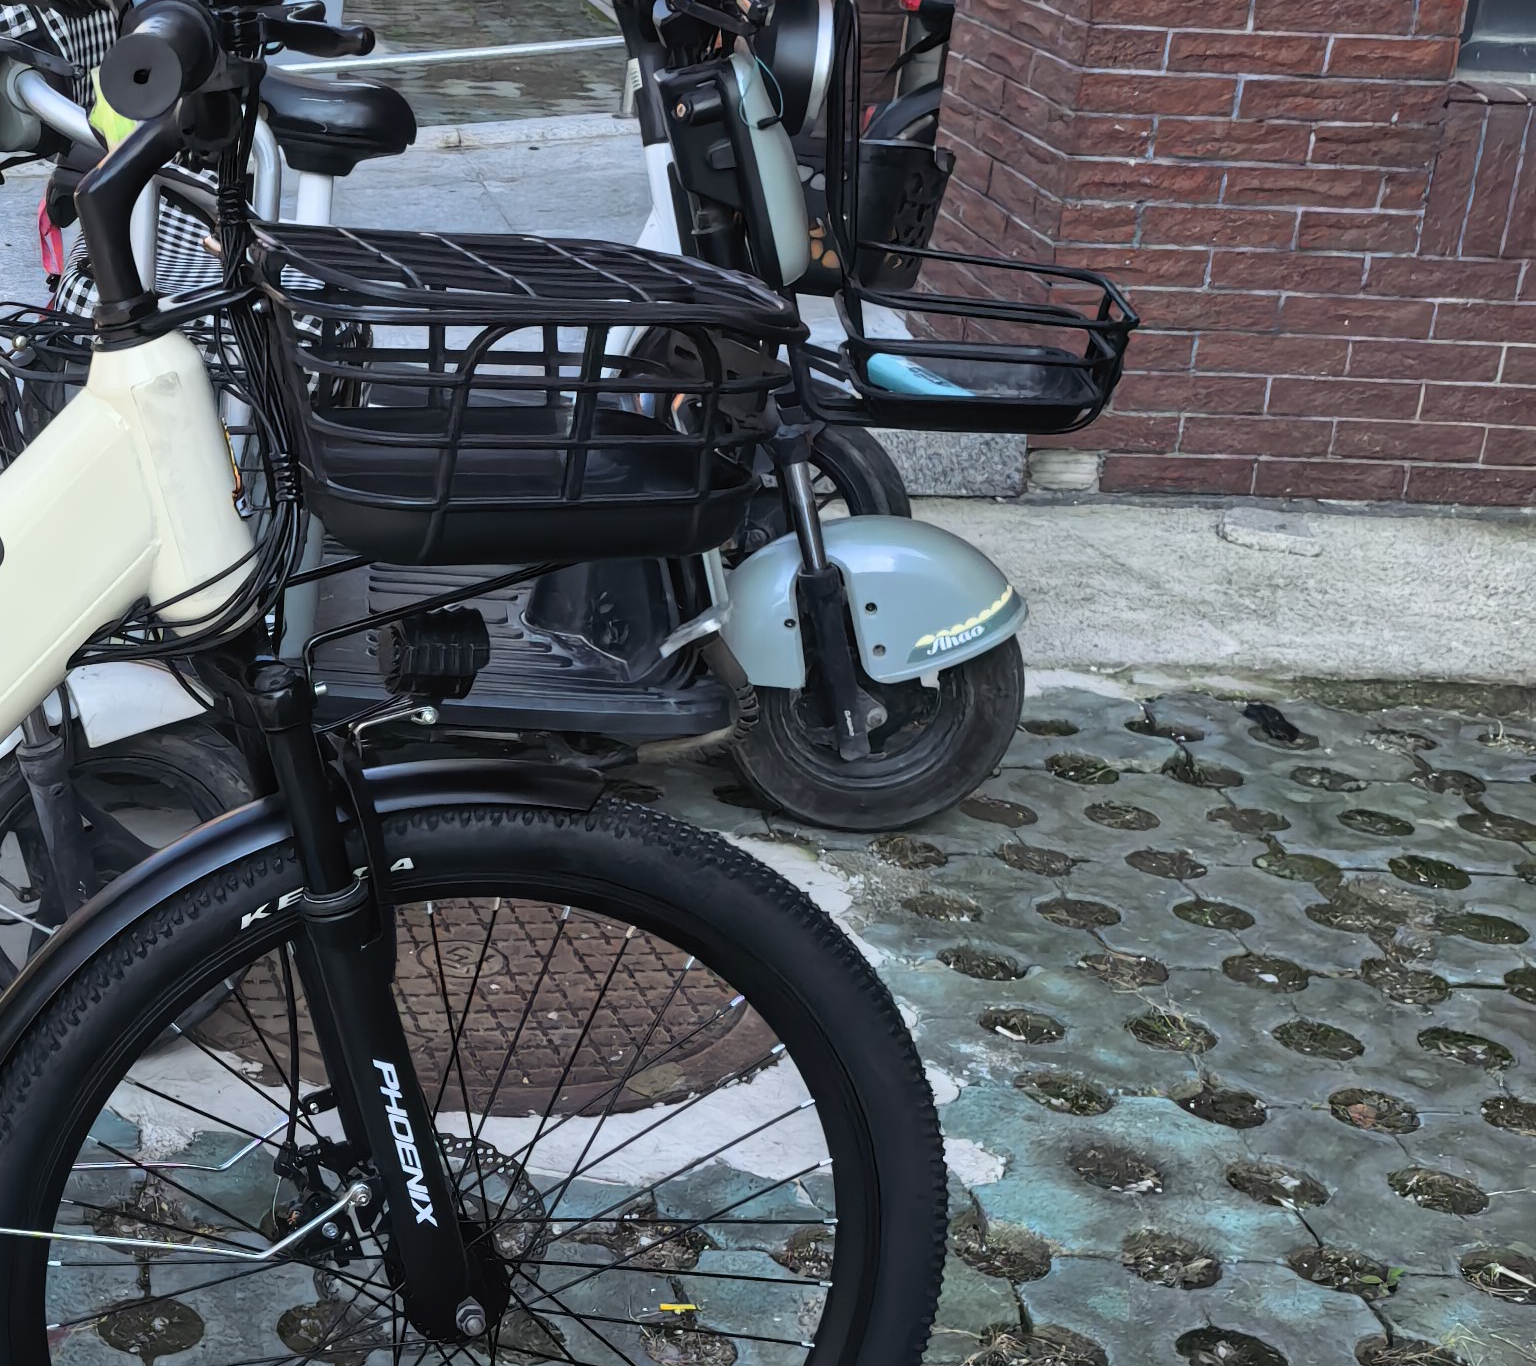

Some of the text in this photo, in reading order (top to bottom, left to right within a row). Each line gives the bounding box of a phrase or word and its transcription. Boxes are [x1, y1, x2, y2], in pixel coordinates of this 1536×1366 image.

[926, 625, 985, 656] Ahao
[240, 857, 415, 930] KEA
[372, 1058, 439, 1228] PHOENIX
